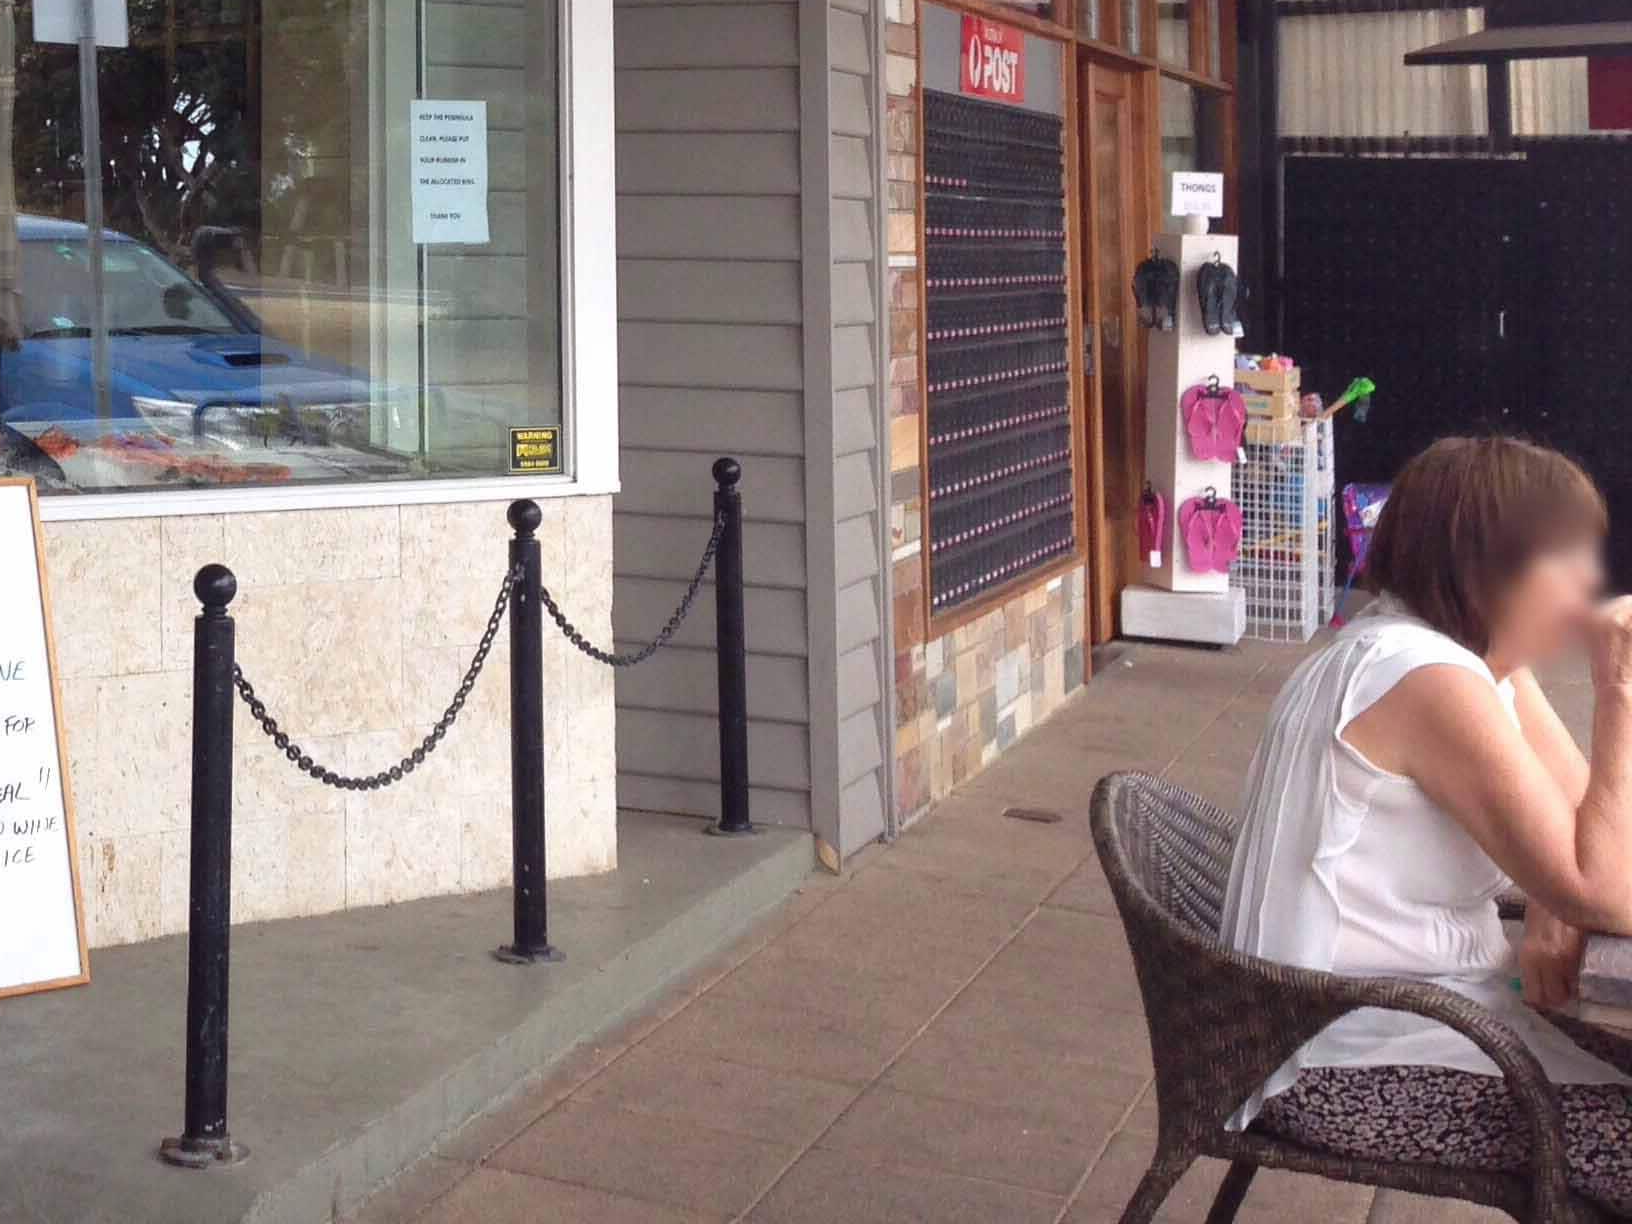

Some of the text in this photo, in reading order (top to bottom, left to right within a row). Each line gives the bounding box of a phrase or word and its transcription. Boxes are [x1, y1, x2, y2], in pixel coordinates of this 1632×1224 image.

[983, 43, 1019, 95] POST
[1180, 183, 1217, 193] THONGS
[517, 431, 553, 440] WARNING
[4, 715, 36, 736] FOR
[4, 845, 36, 868] ICE
